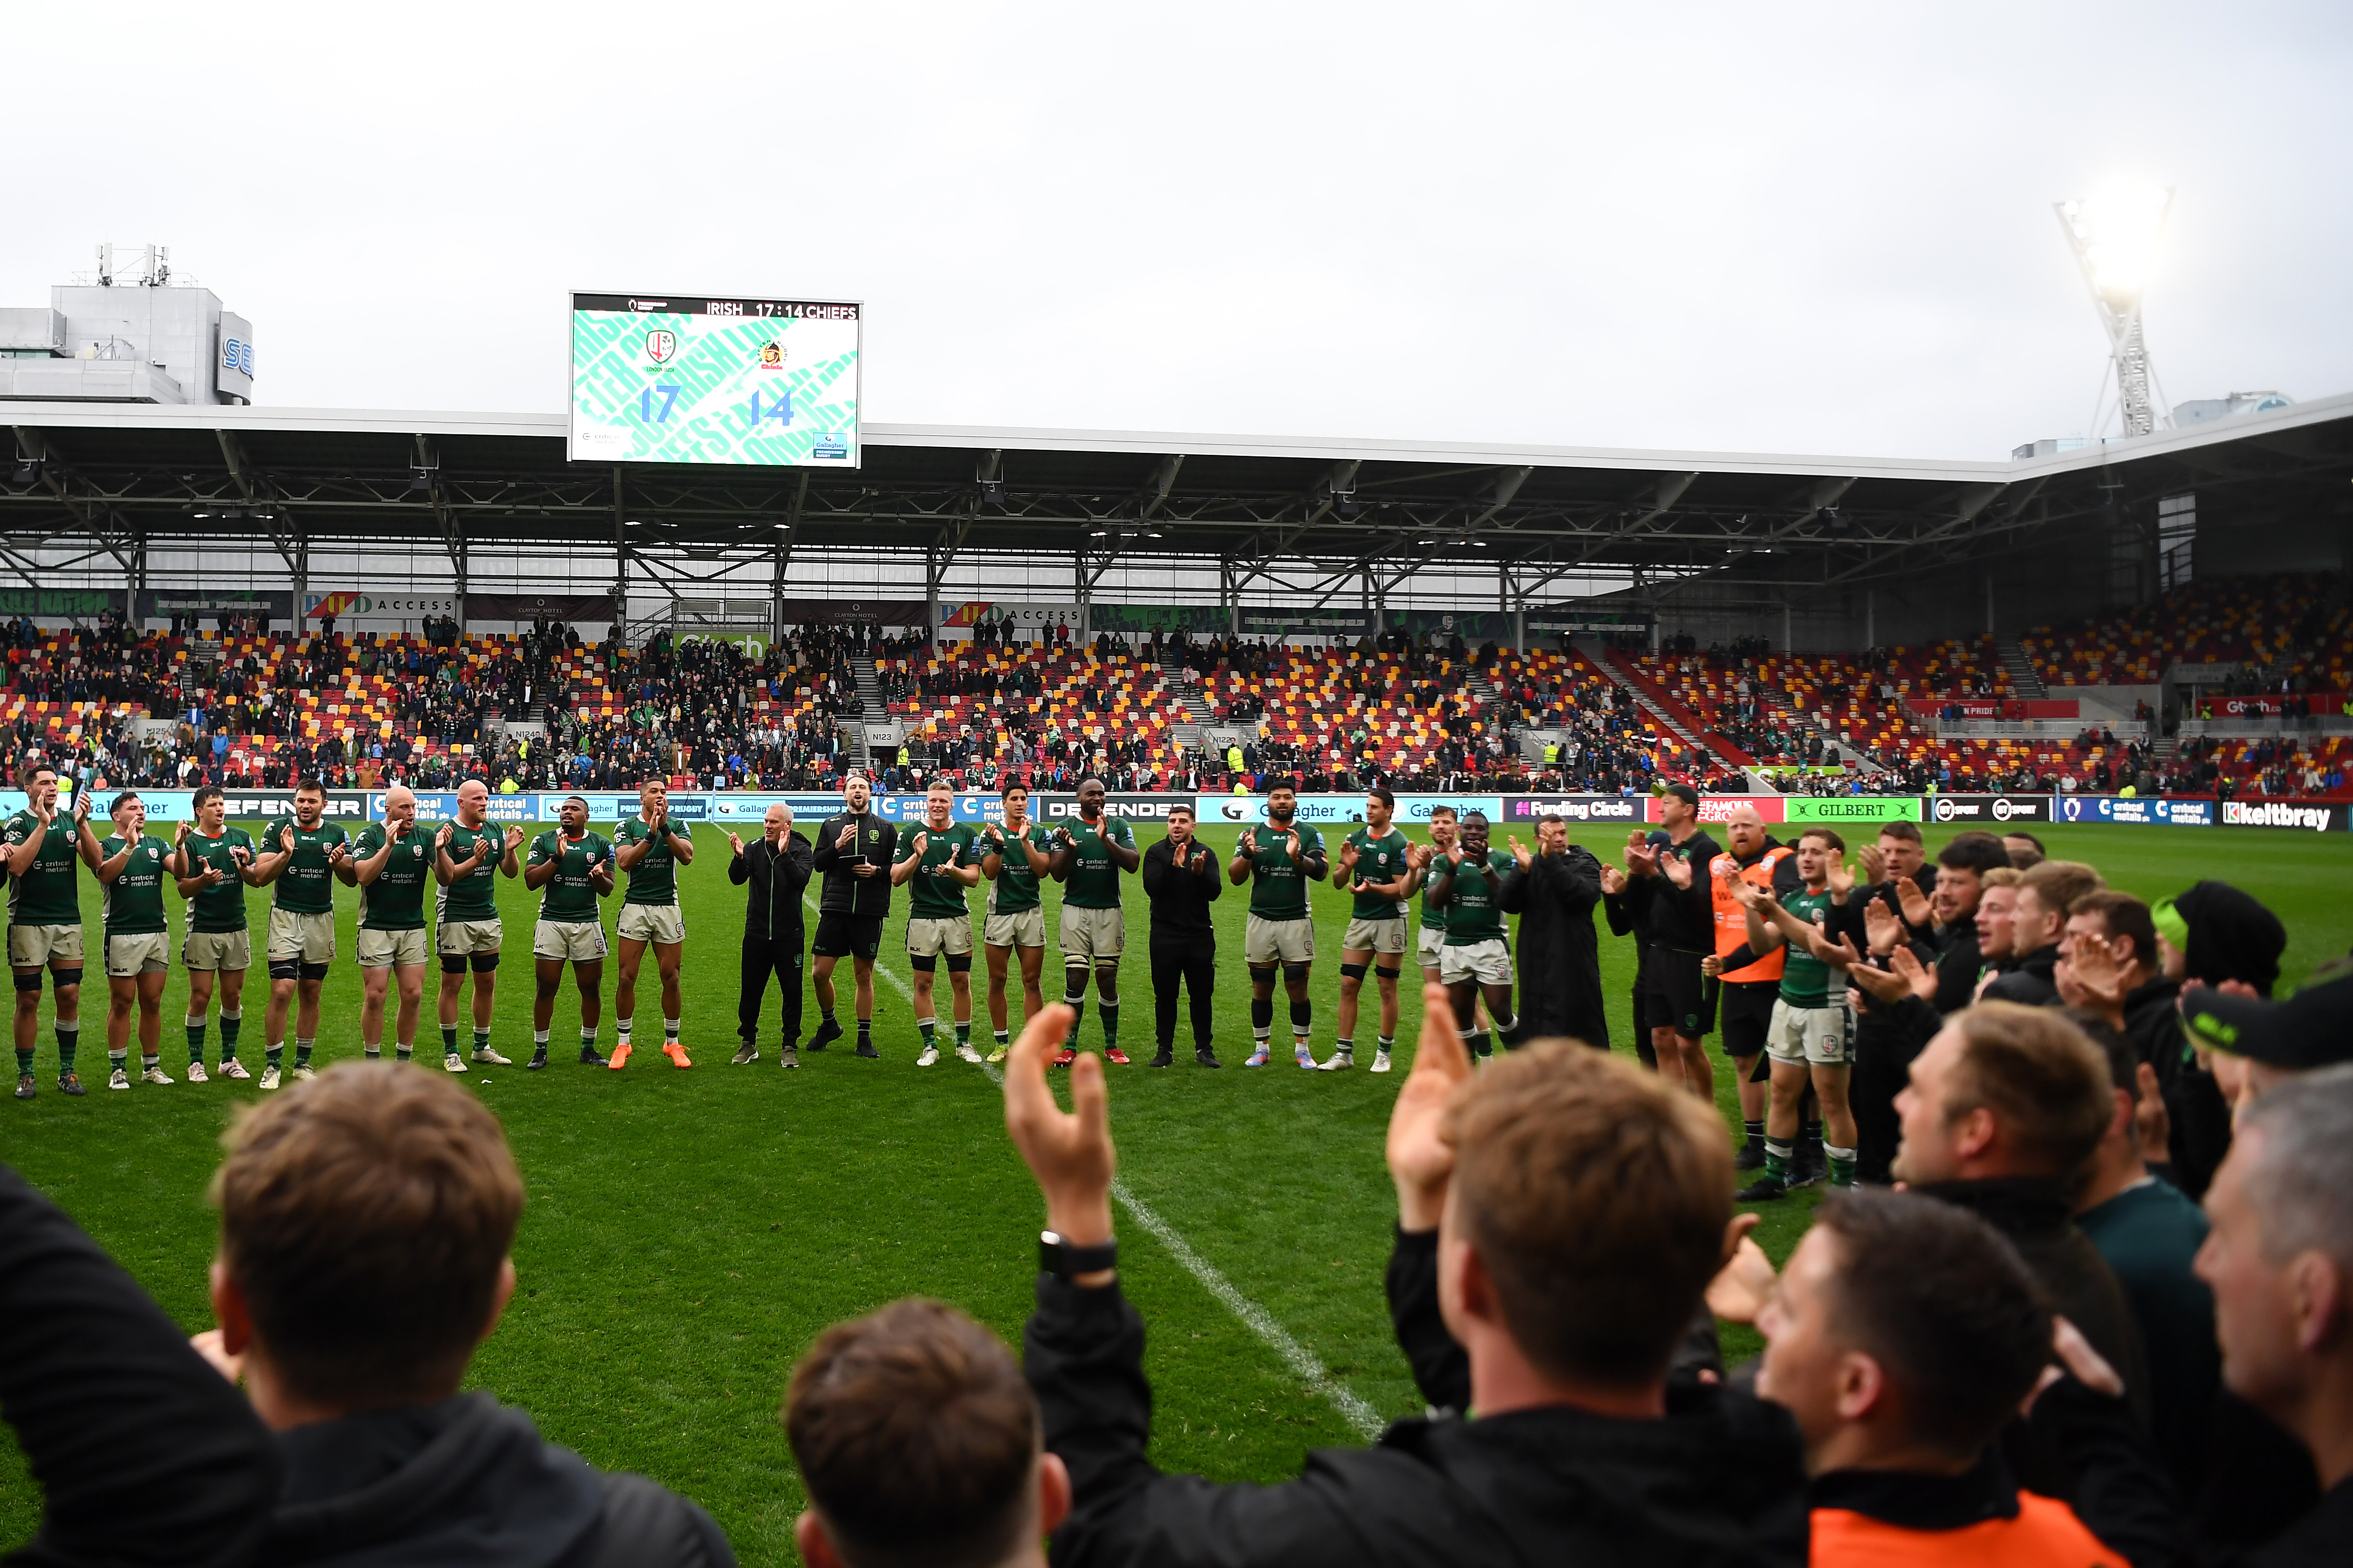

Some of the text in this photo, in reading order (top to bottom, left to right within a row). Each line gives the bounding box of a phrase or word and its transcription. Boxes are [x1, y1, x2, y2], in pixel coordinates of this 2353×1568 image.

[706, 302, 743, 316] IRISH
[806, 306, 856, 320] CHIEFS
[642, 385, 681, 423] 17
[751, 389, 794, 426] 14
[378, 600, 452, 610] ACCESS
[1010, 609, 1078, 620] ACCESS
[225, 799, 361, 815] EFENER
[1530, 801, 1634, 820] Funding Circle
[1819, 804, 1886, 816] GILBERT
[1955, 805, 1979, 815] SPORT
[2011, 805, 2036, 815] SPORT
[2113, 802, 2145, 812] critical
[2170, 803, 2204, 814] critical
[439, 812, 450, 820] plc
[524, 812, 534, 821] plc
[2113, 812, 2142, 822] metals
[2171, 813, 2201, 825] metals
[2240, 802, 2331, 832] keltbray
